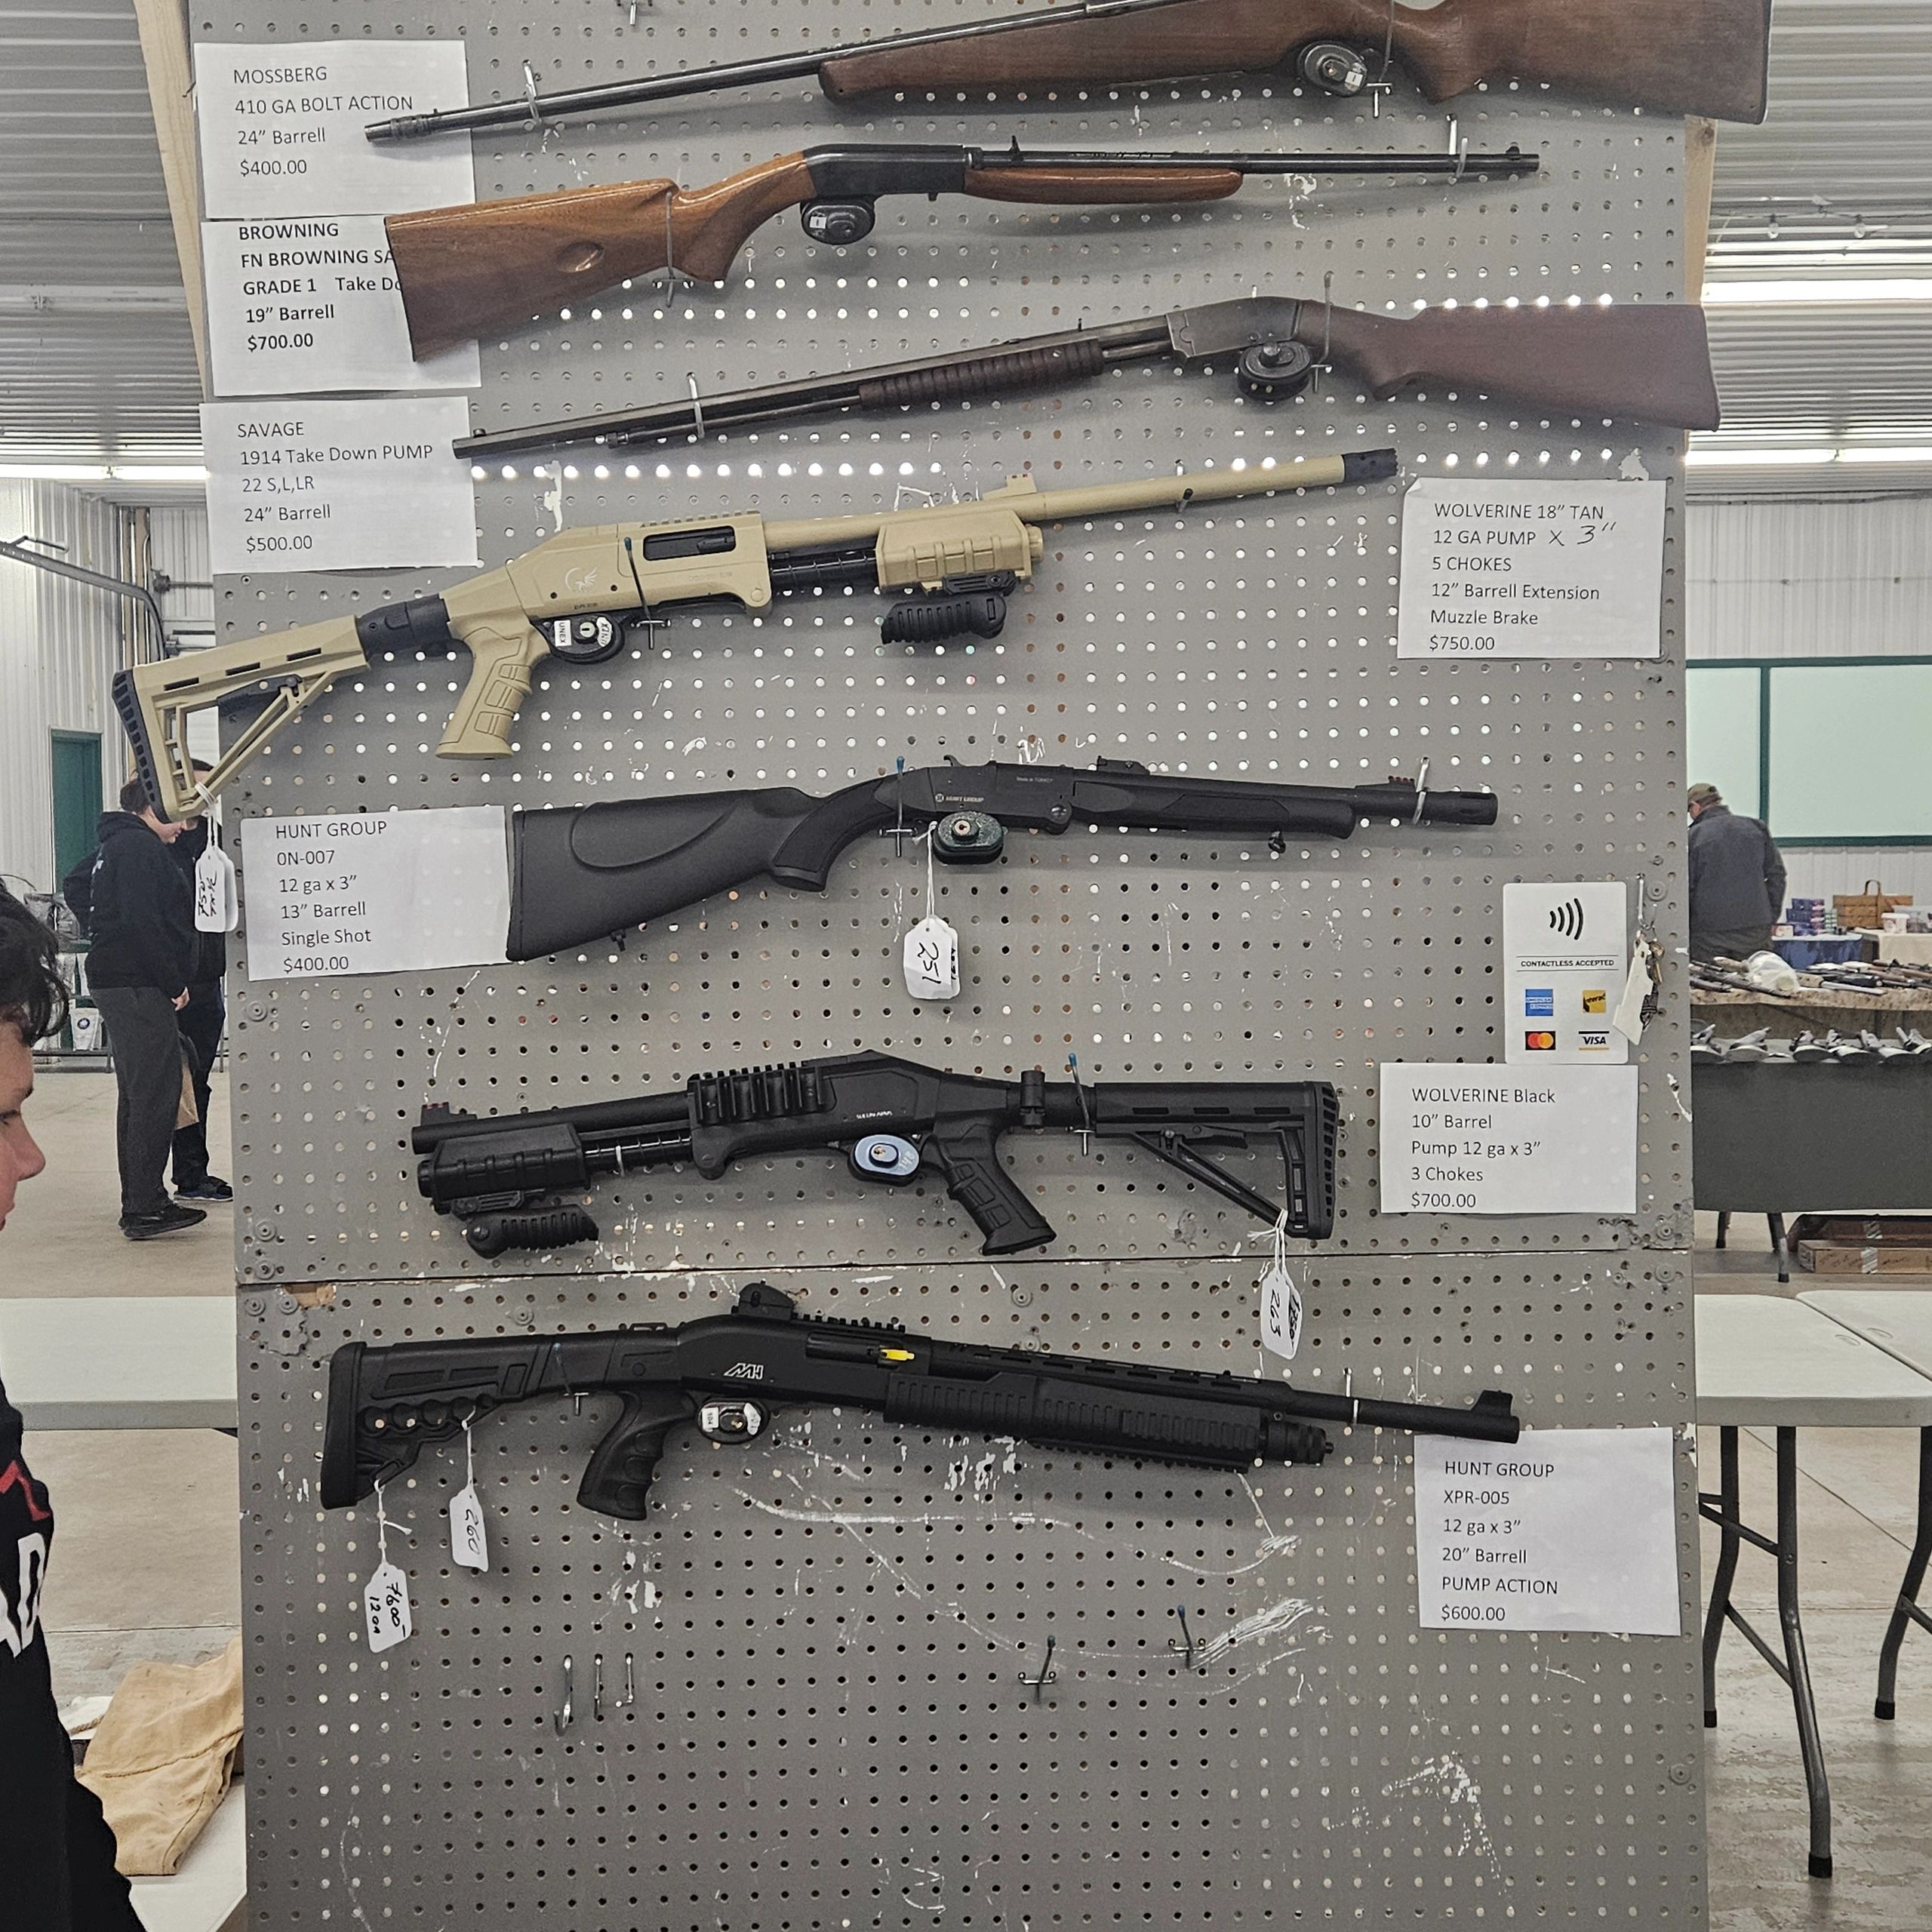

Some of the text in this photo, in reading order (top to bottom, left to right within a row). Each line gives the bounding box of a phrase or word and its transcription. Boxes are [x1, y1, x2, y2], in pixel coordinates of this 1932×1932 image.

[234, 66, 326, 84] MOSSBERG
[235, 96, 412, 114] 410 GA BOLT ACTION
[273, 128, 325, 144] Barrell
[241, 159, 306, 177] $400.00
[239, 223, 338, 240] BROWNING
[242, 254, 263, 268] FN
[269, 250, 368, 266] BROWNING
[244, 279, 301, 295] GRADE
[308, 278, 316, 292] 1
[335, 276, 376, 291] Take
[279, 304, 334, 321] Barrell
[248, 333, 312, 352] $700.00
[238, 422, 304, 438] SAVAGE
[241, 445, 432, 465] 1914 Take Down PUMP
[242, 476, 314, 494] 22 S,L,LR
[279, 504, 330, 520] Barrell
[1435, 503, 1532, 518] WOLVERINE
[1570, 506, 1603, 519] TAN
[247, 535, 312, 553] $500.00
[1434, 530, 1451, 543] 12
[1458, 531, 1481, 543] GA
[1487, 531, 1536, 545] PUMP
[1432, 557, 1512, 571] 5 CHOKES
[1465, 583, 1516, 598] Barrell
[1523, 585, 1599, 599] Extension
[1432, 610, 1537, 624] Muzzle Brake
[1429, 635, 1494, 651] $750.00
[276, 821, 386, 838] HUNT GROUP
[279, 878, 298, 892] 12
[303, 881, 321, 894] ga
[326, 880, 334, 891] x
[314, 901, 365, 918] Barrell
[282, 929, 371, 948] Single Shot
[284, 956, 349, 974] $400.00
[1582, 1036, 1607, 1044] VISA
[1412, 1088, 1555, 1103] WOLVERINE Black
[1445, 1115, 1491, 1128] Barrel
[1413, 1141, 1457, 1158] Pump
[1463, 1142, 1481, 1155] 12
[1487, 1146, 1505, 1158] ga
[1511, 1146, 1518, 1155] x
[1411, 1167, 1483, 1181] 3 Chokes
[1411, 1192, 1475, 1208] $700.00
[1445, 1461, 1554, 1477] HUNT GROUP
[1444, 1491, 1509, 1504] XPR-005
[1444, 1519, 1461, 1532] 12
[1467, 1523, 1484, 1536] ga
[1491, 1523, 1498, 1534] x
[1476, 1549, 1526, 1564] Barrell
[1443, 1577, 1557, 1594] PUMP ACTION
[1441, 1604, 1505, 1621] $600.00
